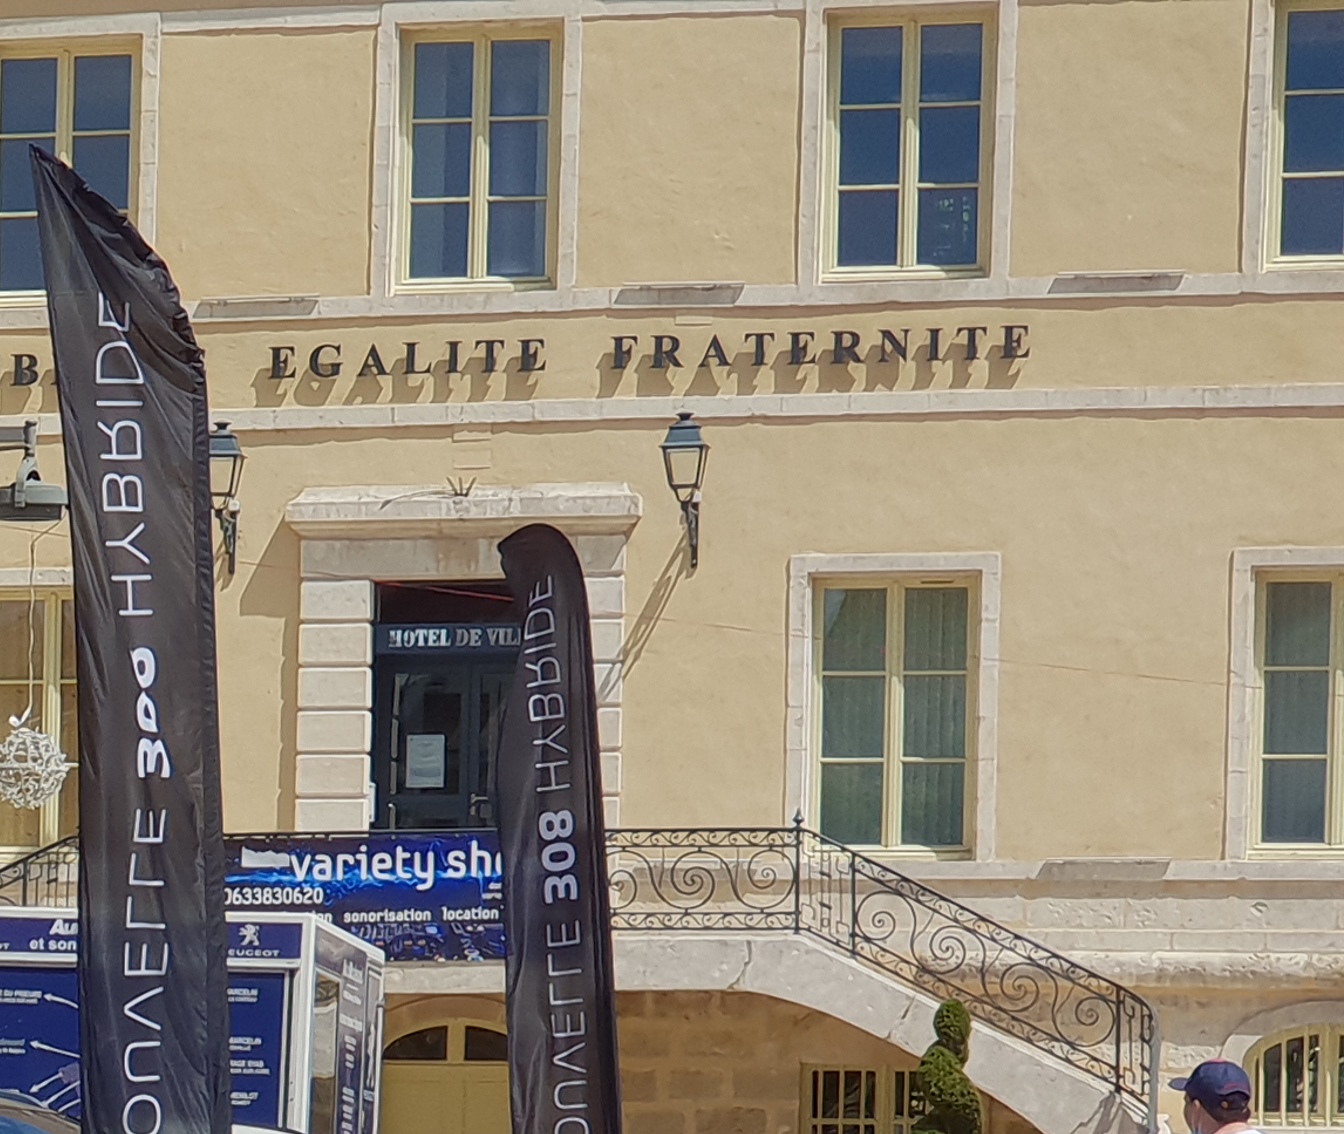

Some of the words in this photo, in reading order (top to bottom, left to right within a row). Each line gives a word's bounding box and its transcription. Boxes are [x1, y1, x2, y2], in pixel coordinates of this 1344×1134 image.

[268, 338, 547, 379] EGALITE
[610, 324, 1032, 370] FRATERNITE
[388, 628, 451, 648] HOTEL
[455, 628, 482, 647] DE
[486, 627, 521, 646] VIL
[289, 843, 435, 891] variety
[343, 908, 432, 923] sonorisation
[29, 937, 45, 951] et
[227, 948, 281, 957] EUGEOT
